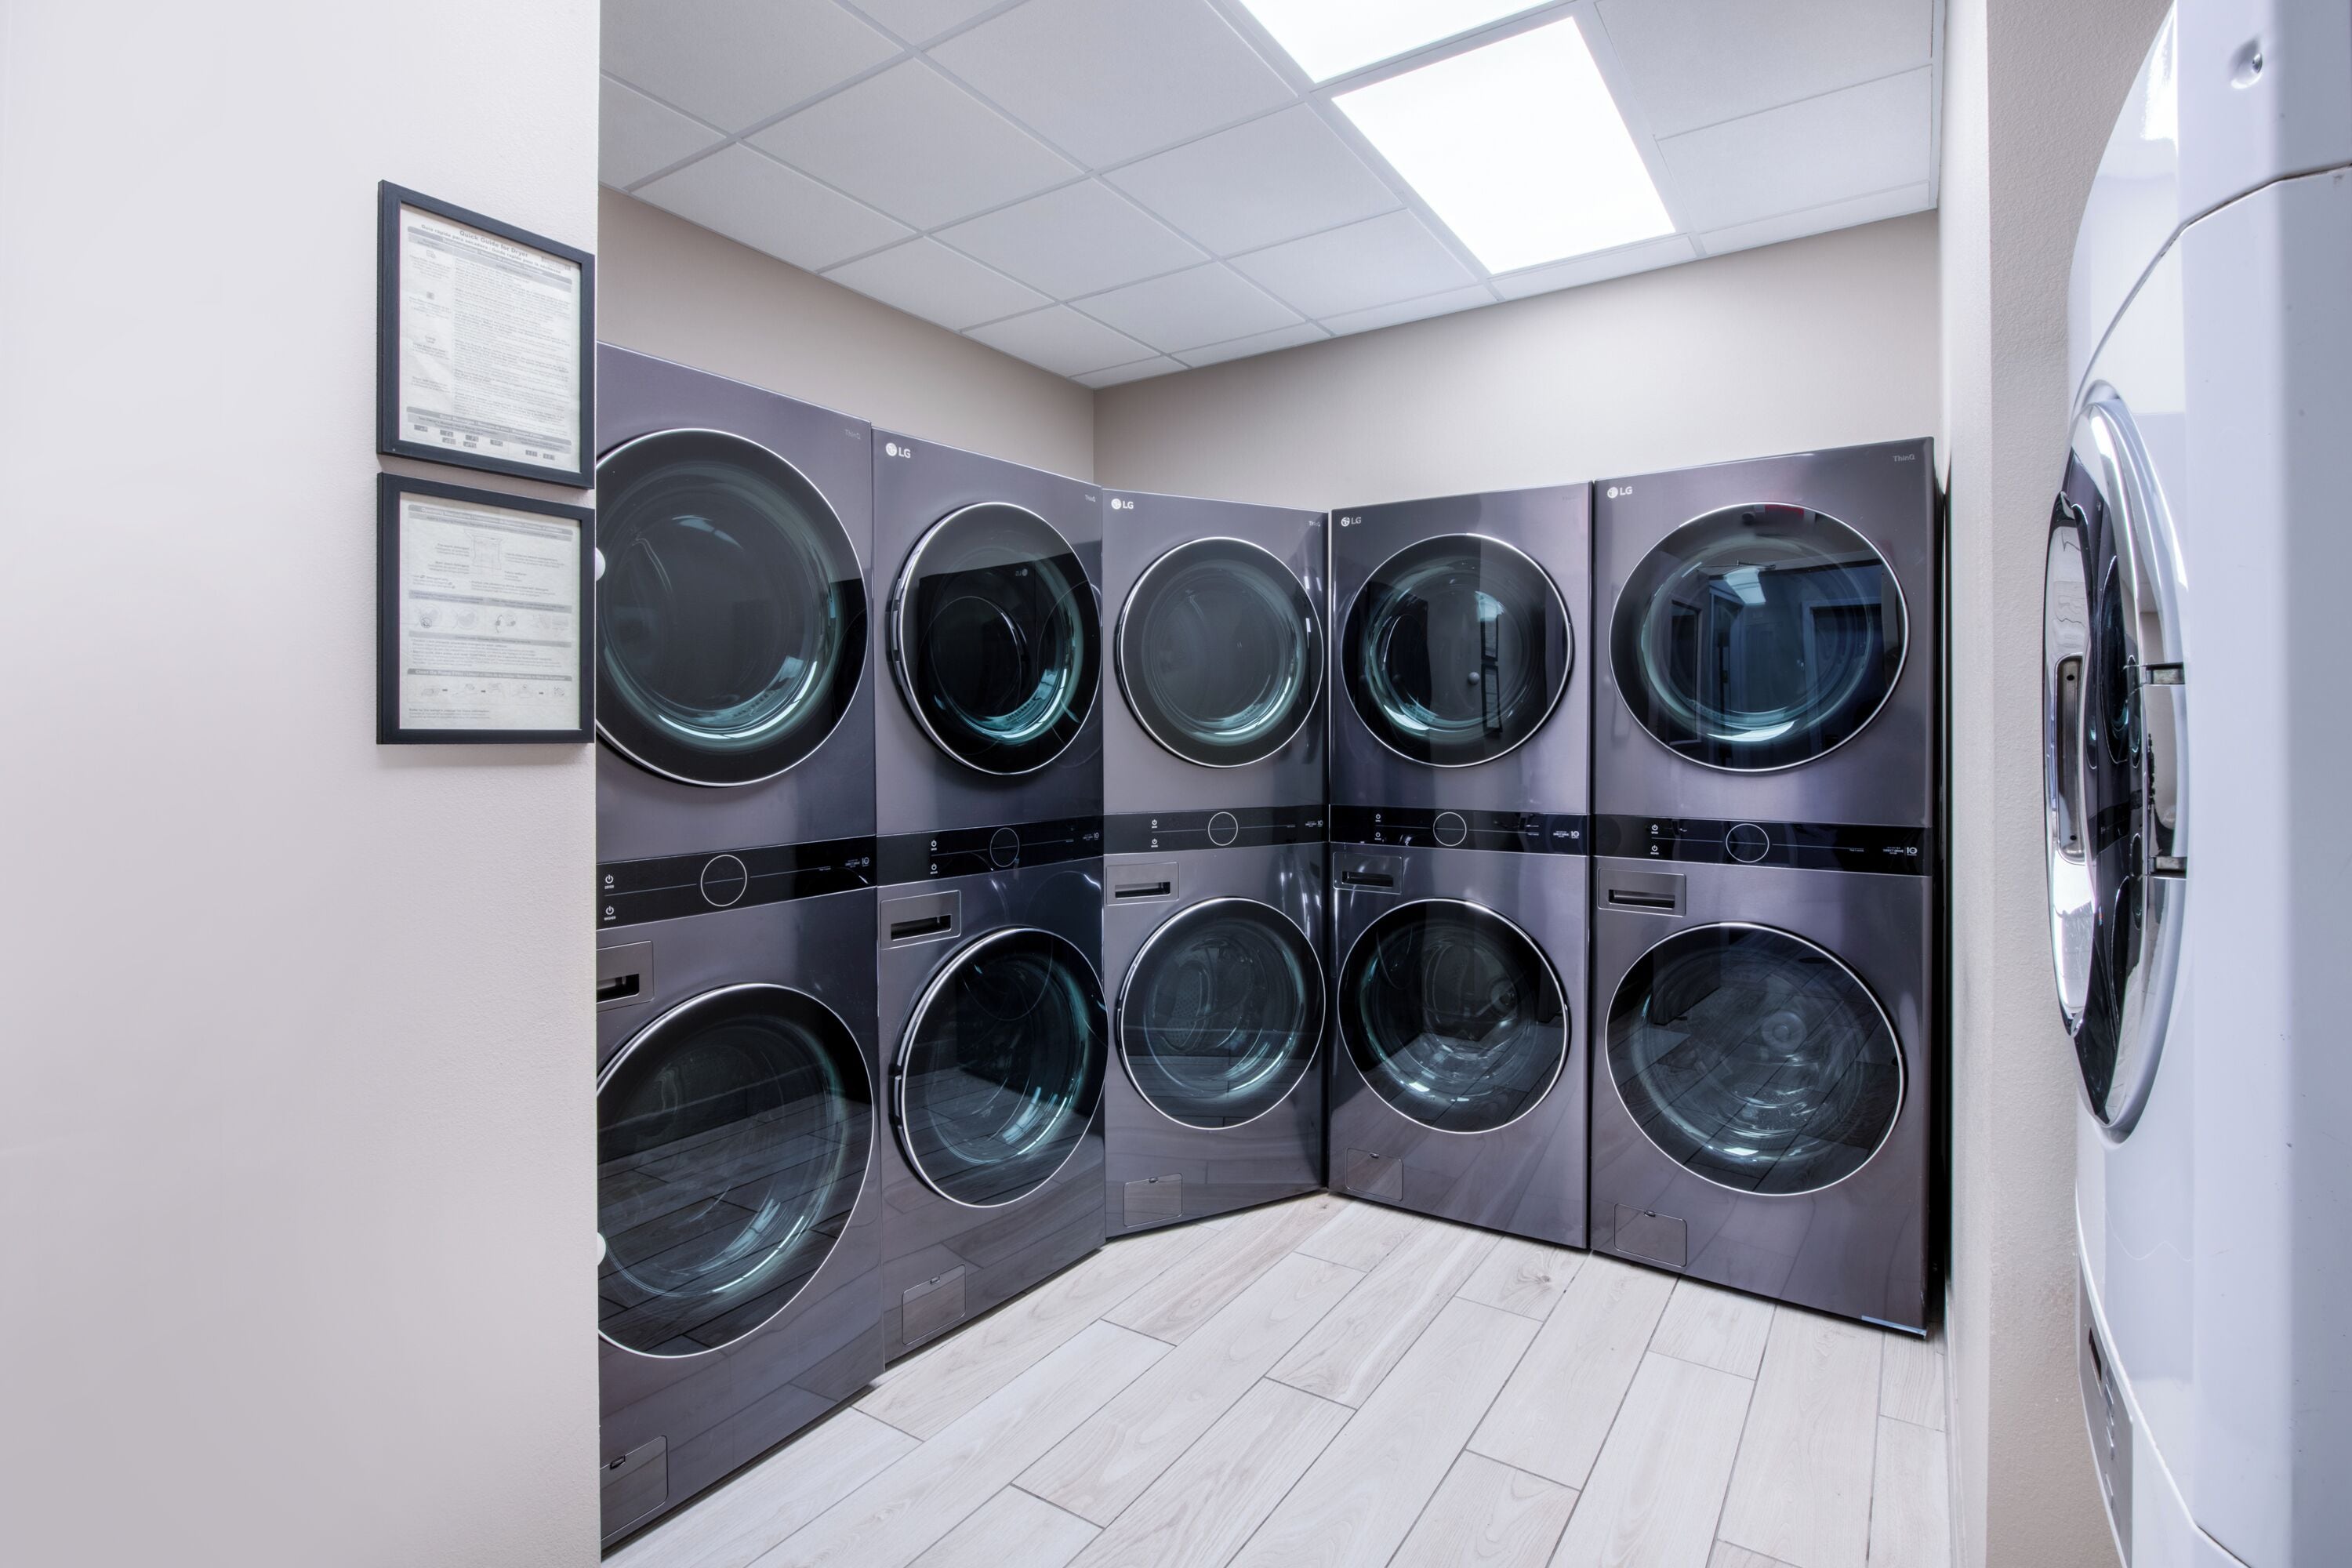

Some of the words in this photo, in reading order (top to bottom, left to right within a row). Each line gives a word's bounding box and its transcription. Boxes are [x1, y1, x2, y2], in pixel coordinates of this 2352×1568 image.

[459, 230, 478, 241] Quick
[480, 237, 499, 248] Guide
[511, 247, 528, 258] Dryer
[898, 446, 911, 459] LG
[1893, 453, 1915, 463] ThinQ
[1619, 485, 1633, 495] LG
[1122, 500, 1134, 510] LG
[862, 856, 869, 865] 10
